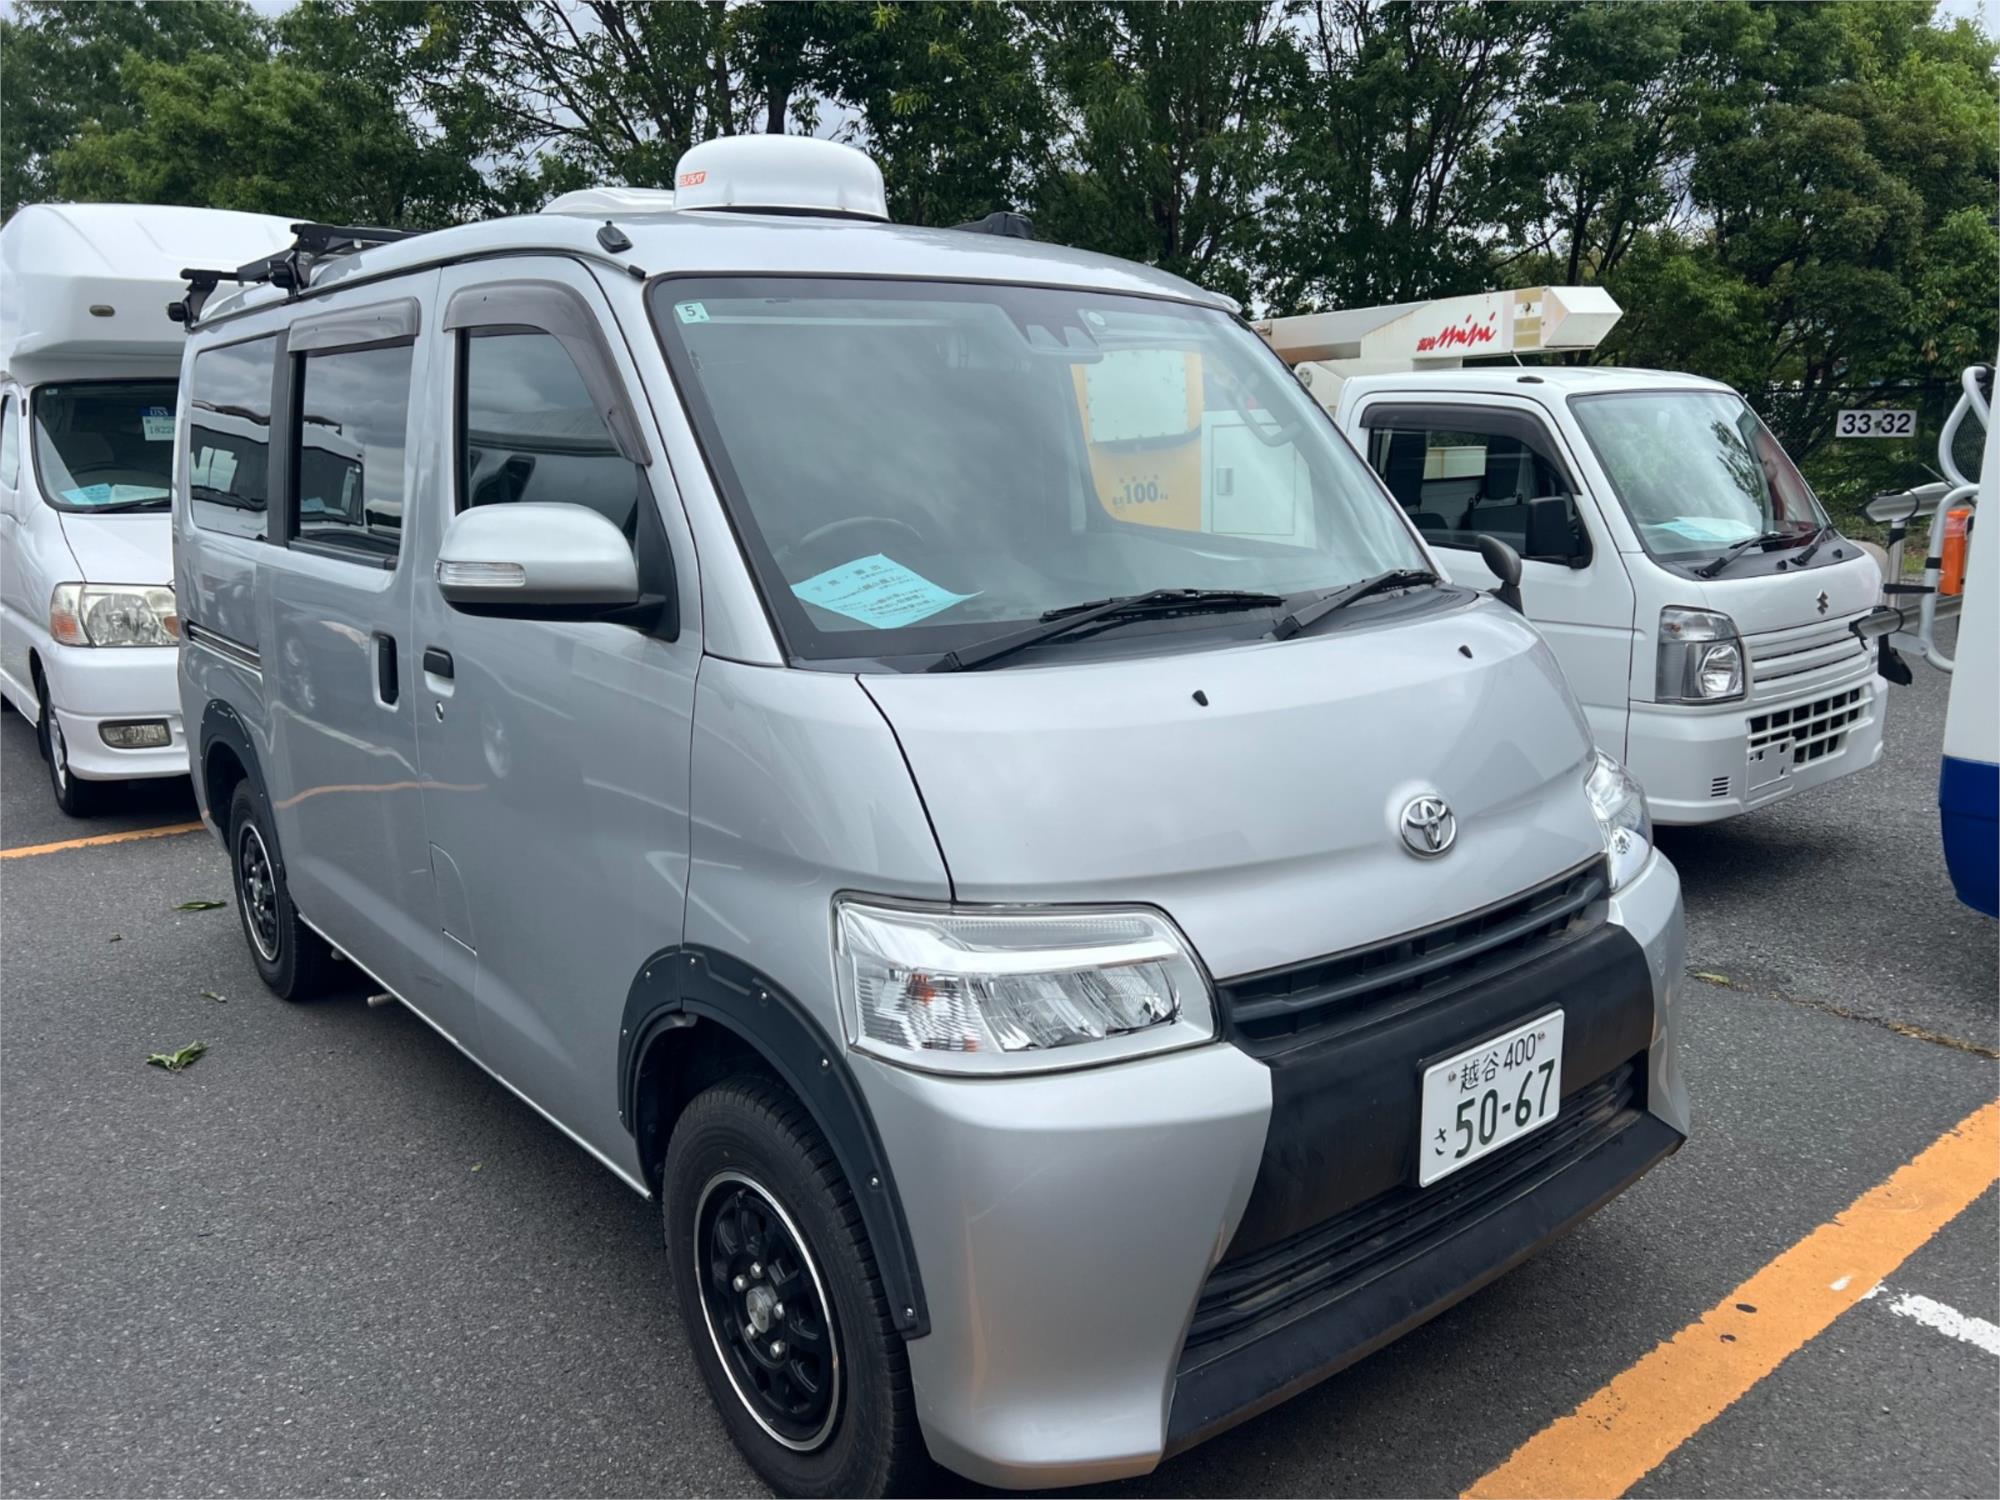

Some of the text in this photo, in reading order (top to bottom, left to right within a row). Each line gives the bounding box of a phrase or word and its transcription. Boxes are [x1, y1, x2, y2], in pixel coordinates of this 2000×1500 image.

[684, 305, 696, 317] 5
[1460, 1033, 1536, 1094] 越谷 400
[1433, 1058, 1555, 1159] さ 50-67
